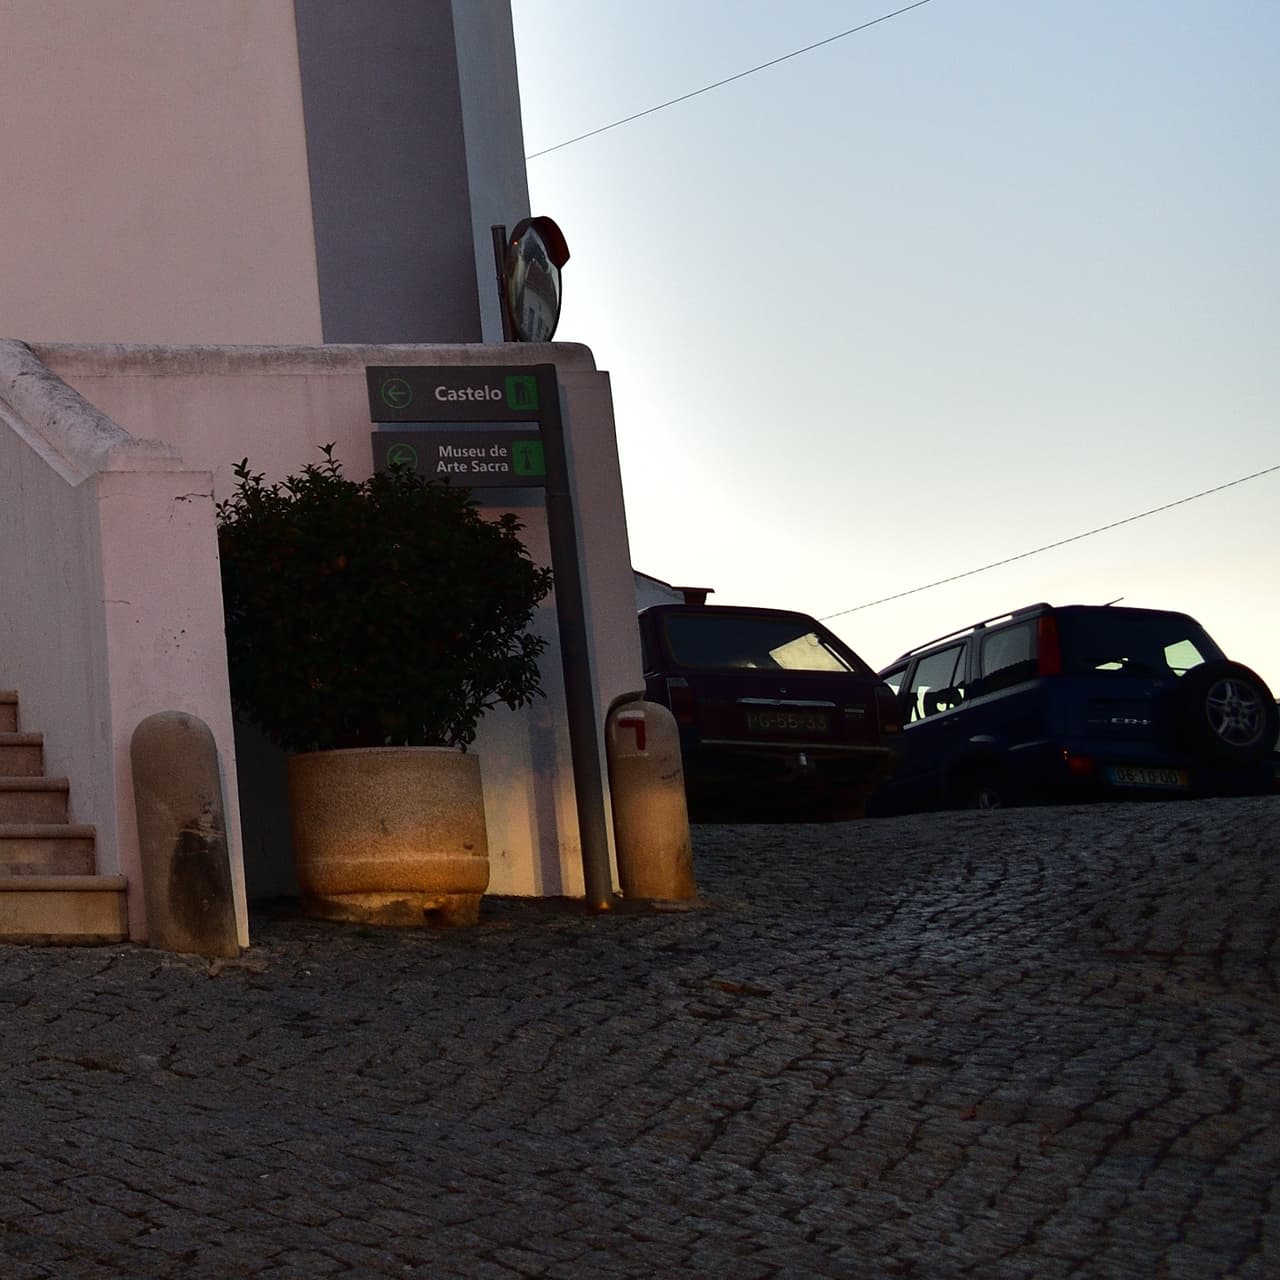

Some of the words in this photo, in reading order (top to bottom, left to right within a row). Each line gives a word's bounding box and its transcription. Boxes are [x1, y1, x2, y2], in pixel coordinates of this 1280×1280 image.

[434, 385, 504, 402] Castelo
[438, 445, 486, 458] Museu
[490, 444, 508, 457] de
[436, 460, 468, 473] Arte
[471, 460, 509, 473] Sacra
